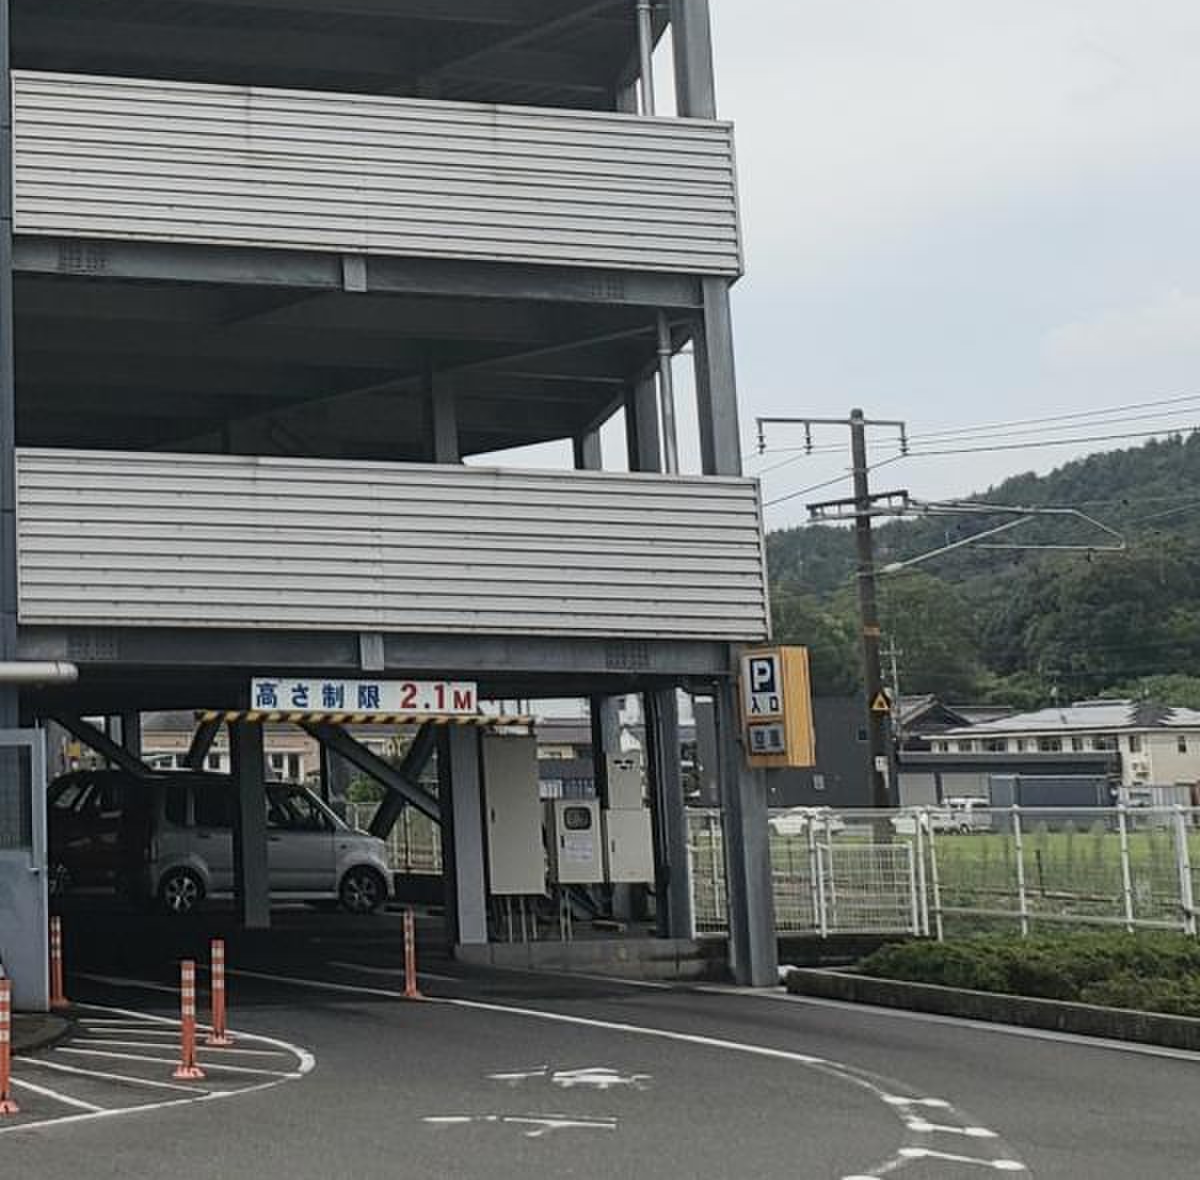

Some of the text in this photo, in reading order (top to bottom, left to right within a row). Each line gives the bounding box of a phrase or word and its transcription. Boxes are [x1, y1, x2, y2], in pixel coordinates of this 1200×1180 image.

[753, 660, 770, 690] P
[256, 682, 472, 709] 高さ制限 2.1M
[751, 695, 779, 713] 入口
